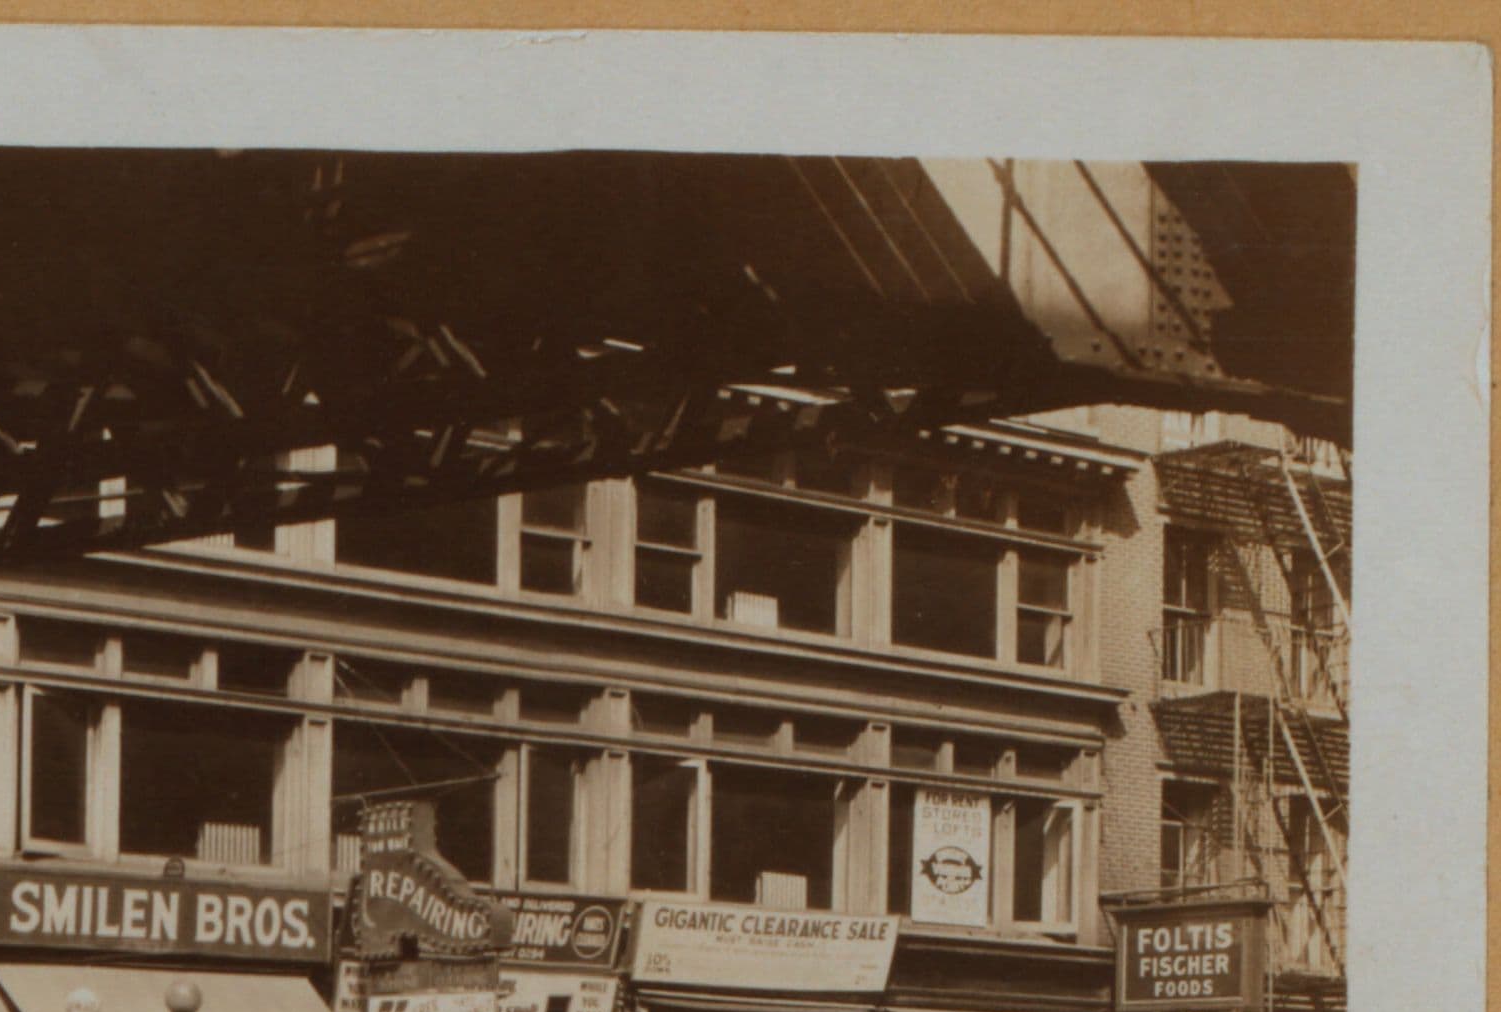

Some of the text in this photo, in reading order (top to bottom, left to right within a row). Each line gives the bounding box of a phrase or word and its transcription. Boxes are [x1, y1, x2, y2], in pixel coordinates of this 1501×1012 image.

[10, 881, 316, 949] SMILEN BROS.
[369, 869, 487, 940] REPAIRING
[654, 907, 890, 941] GIGANTIC CLEARANCE SALE
[1137, 922, 1234, 954] FOLTIS
[1139, 954, 1229, 978] FISCHER
[1154, 979, 1214, 998] FOODS
